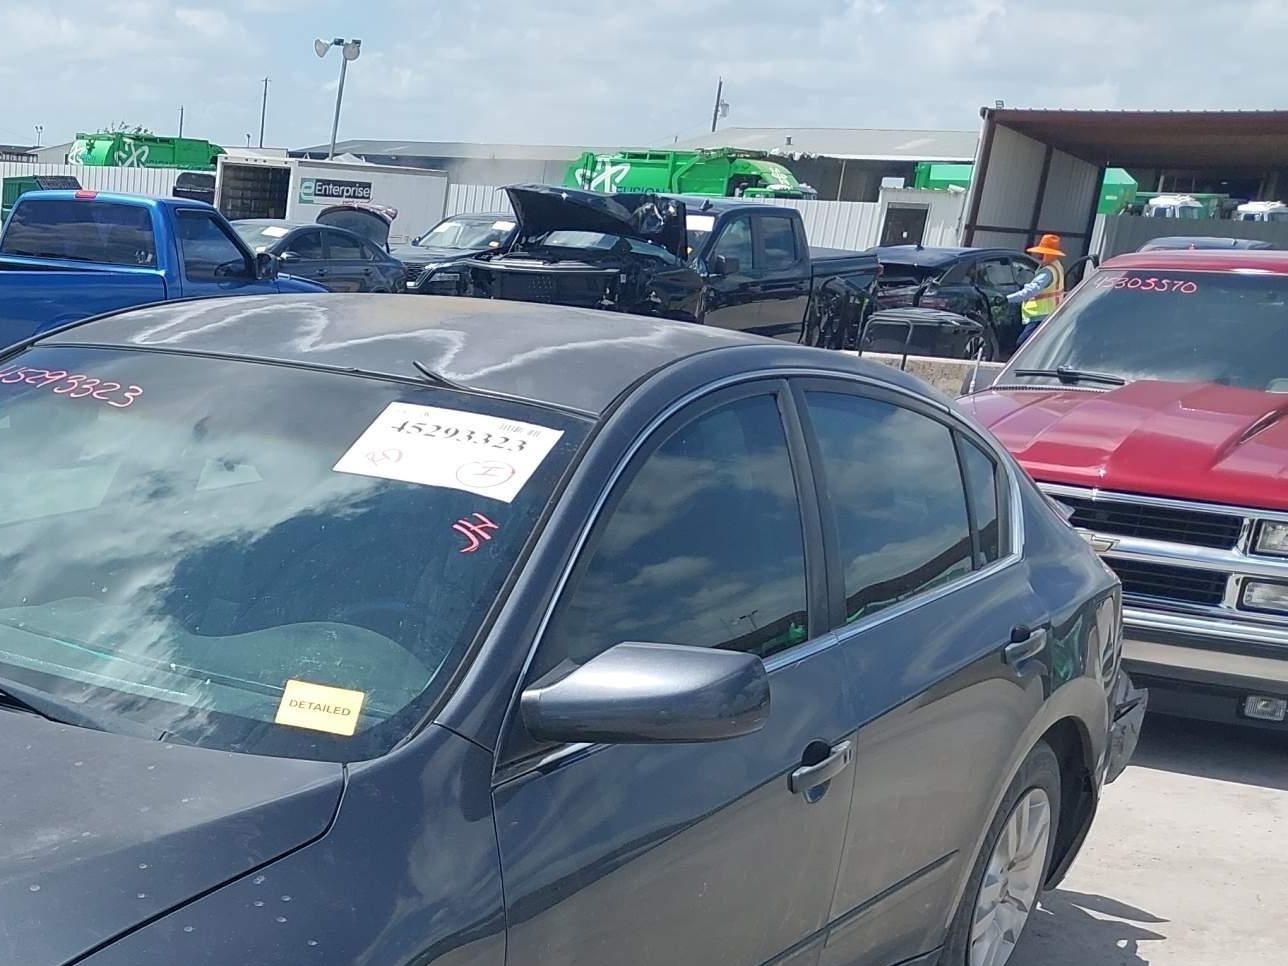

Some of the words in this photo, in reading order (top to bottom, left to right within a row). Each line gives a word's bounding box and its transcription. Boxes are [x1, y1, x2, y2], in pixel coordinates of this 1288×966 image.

[314, 181, 371, 199] Enterprise
[391, 419, 529, 452] 45293323
[288, 699, 352, 717] DETAILED
